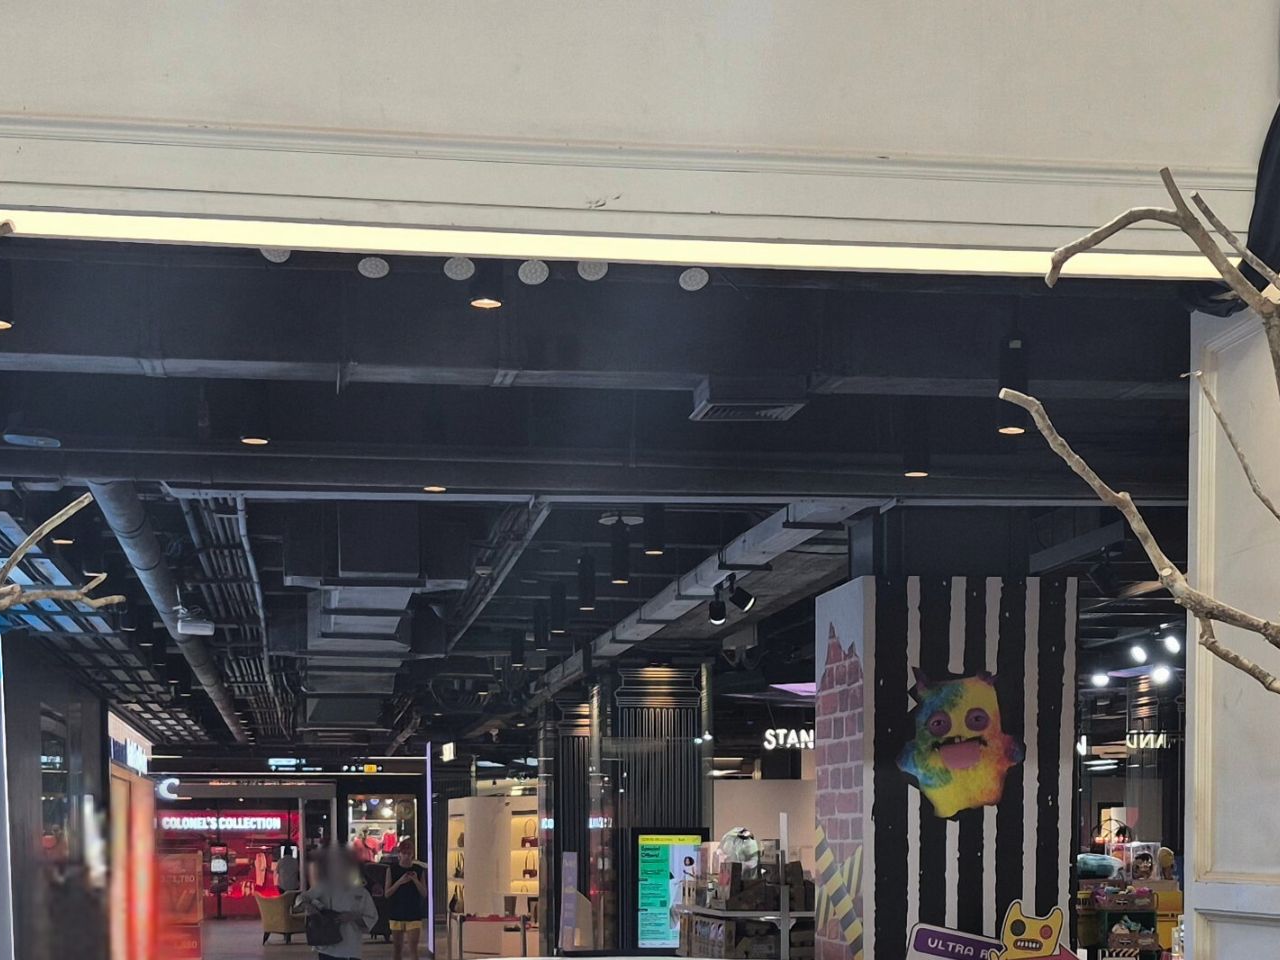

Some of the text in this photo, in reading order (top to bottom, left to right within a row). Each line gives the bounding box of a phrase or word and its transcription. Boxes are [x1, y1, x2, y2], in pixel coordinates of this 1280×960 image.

[763, 728, 815, 751] STAN
[218, 816, 281, 830] COLLECTION
[927, 936, 975, 956] ULTRA
